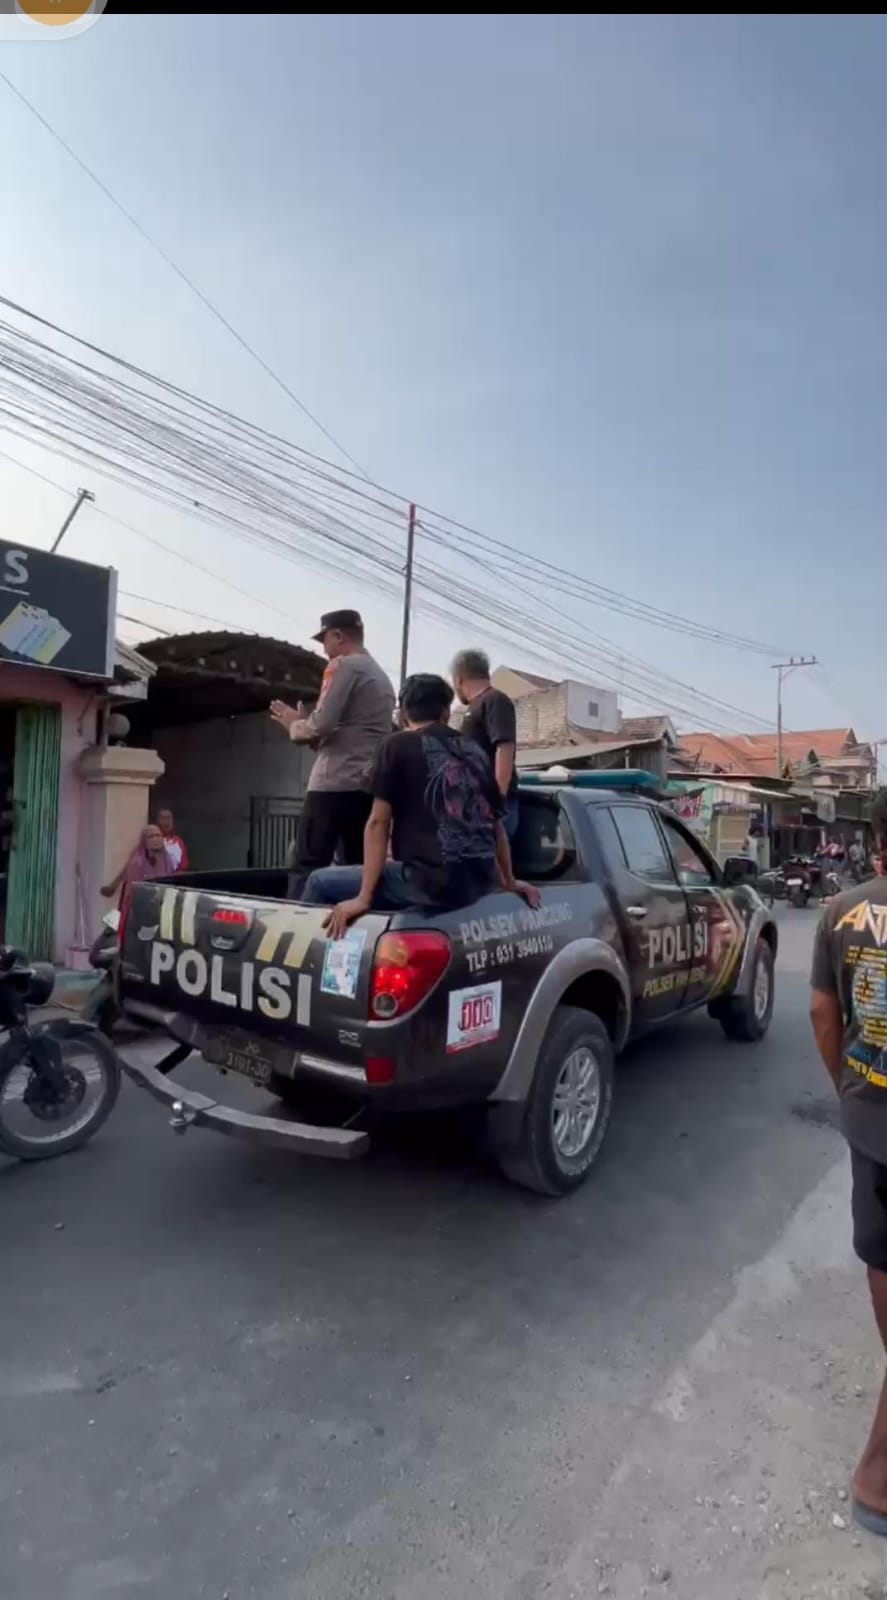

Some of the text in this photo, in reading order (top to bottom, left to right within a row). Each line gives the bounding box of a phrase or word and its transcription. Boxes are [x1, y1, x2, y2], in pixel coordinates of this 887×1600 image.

[460, 913, 519, 946] POLSEK
[648, 921, 708, 968] POLISI
[466, 950, 487, 972] TLP
[496, 944, 514, 964] 031
[150, 942, 313, 1027] POLISI
